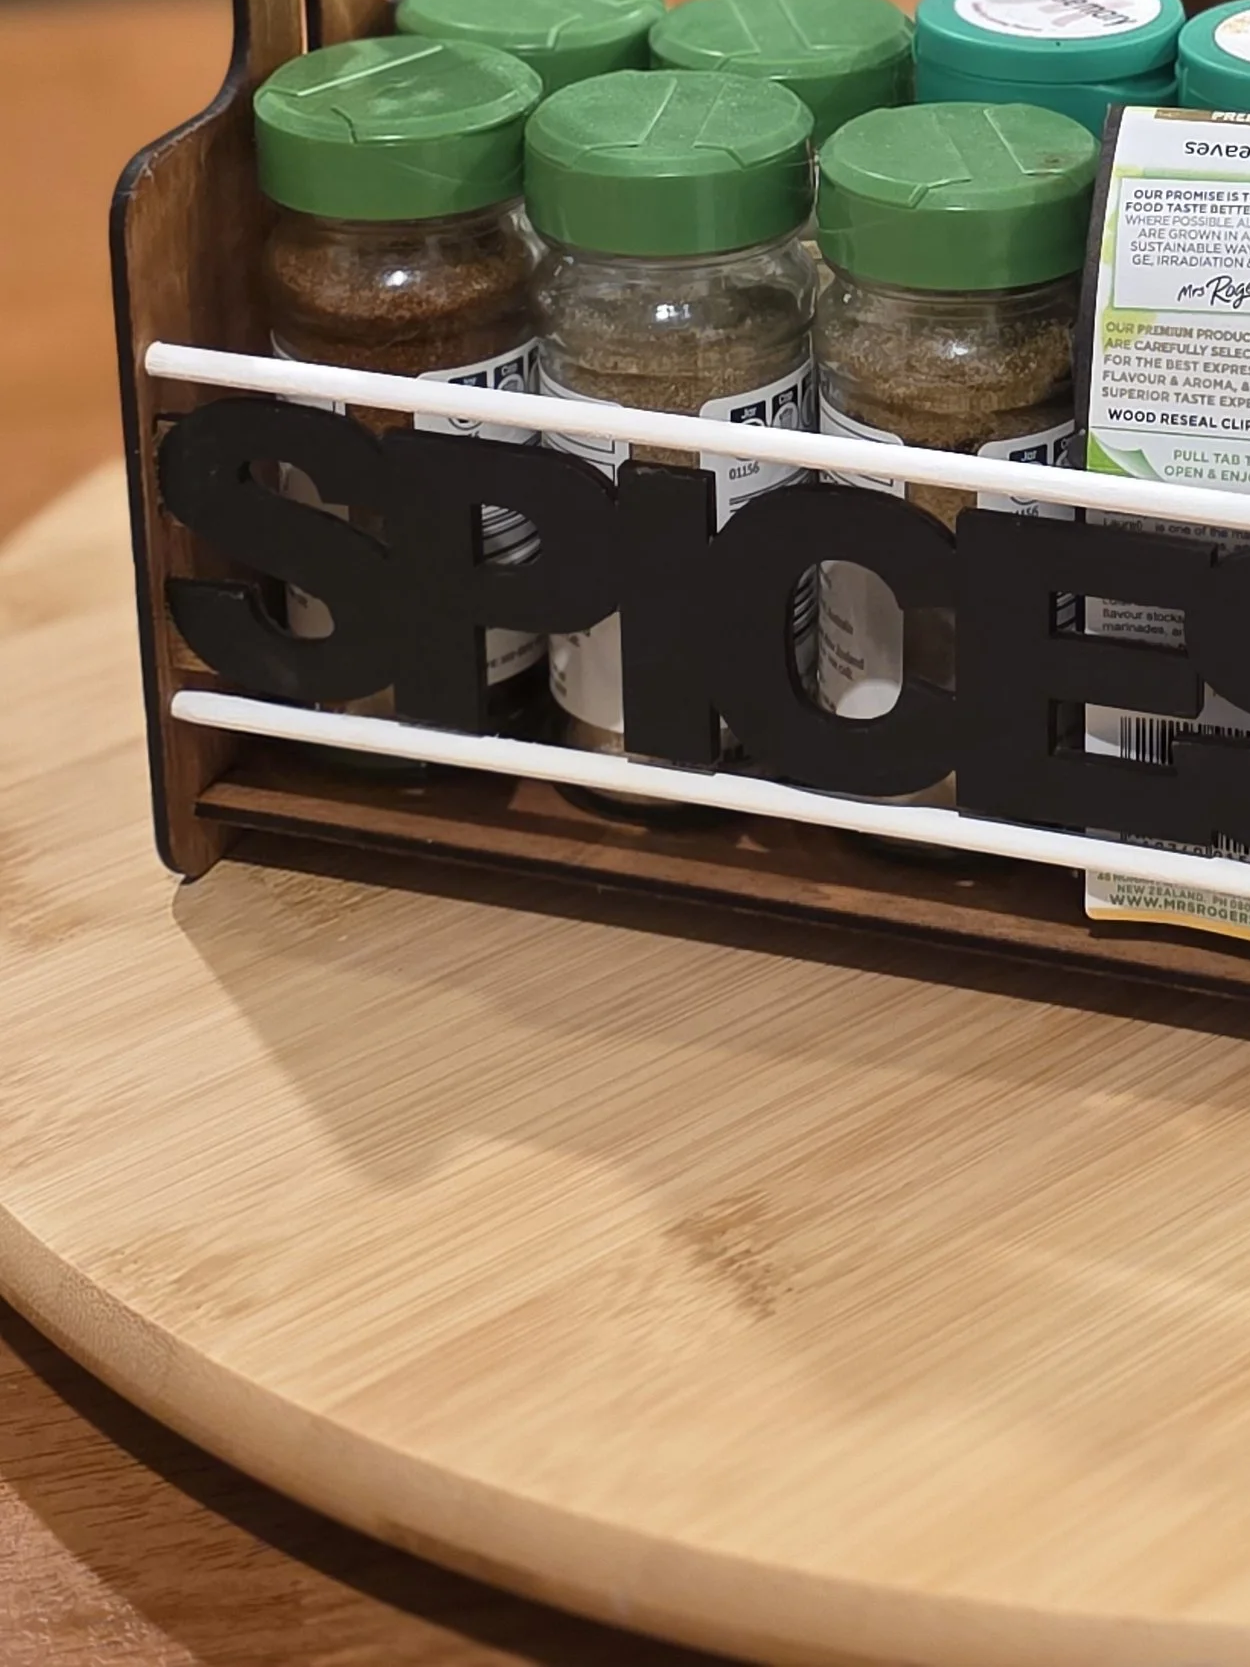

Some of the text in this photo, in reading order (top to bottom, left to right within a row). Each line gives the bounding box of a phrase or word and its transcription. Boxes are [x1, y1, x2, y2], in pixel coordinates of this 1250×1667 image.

[1134, 190, 1163, 199] OUR
[1166, 190, 1224, 201] PROMISE
[1227, 192, 1238, 201] IS
[1125, 202, 1163, 212] FOOD
[1167, 203, 1207, 213] TASTE
[1125, 215, 1170, 225] WHERE
[1138, 228, 1165, 239] ARE
[1169, 229, 1221, 240] GROWN
[1224, 231, 1238, 240] IN
[1241, 231, 1250, 241] A
[1131, 241, 1221, 254] SUSTAINABLE
[1157, 255, 1244, 268] IRRADIATION
[1177, 285, 1204, 301] Mrs
[1106, 322, 1134, 334] OUR
[1137, 324, 1193, 338] PREMIUM
[1104, 338, 1131, 350] ARE
[1134, 341, 1208, 356] CAREFULLY
[1104, 354, 1131, 366] FOR
[1136, 356, 1162, 368] THE
[1166, 359, 1199, 371] BEST
[1103, 370, 1166, 385] FLAVOUR
[1170, 376, 1178, 386] &
[1241, 382, 1249, 391] &
[1102, 387, 1169, 402] SUPERIOR
[1174, 392, 1215, 405] TASTE
[1108, 409, 1156, 423] WOOD
[1160, 413, 1217, 428] RESEAL
[1174, 450, 1209, 463] PULL
[1213, 453, 1240, 465] TAB
[728, 460, 761, 481] 01156
[1165, 466, 1203, 478] OPEN
[1208, 469, 1215, 479] &
[1168, 524, 1191, 535] one
[1102, 608, 1143, 620] flavour
[1102, 622, 1169, 637] marinades,
[1117, 884, 1146, 895] NEW
